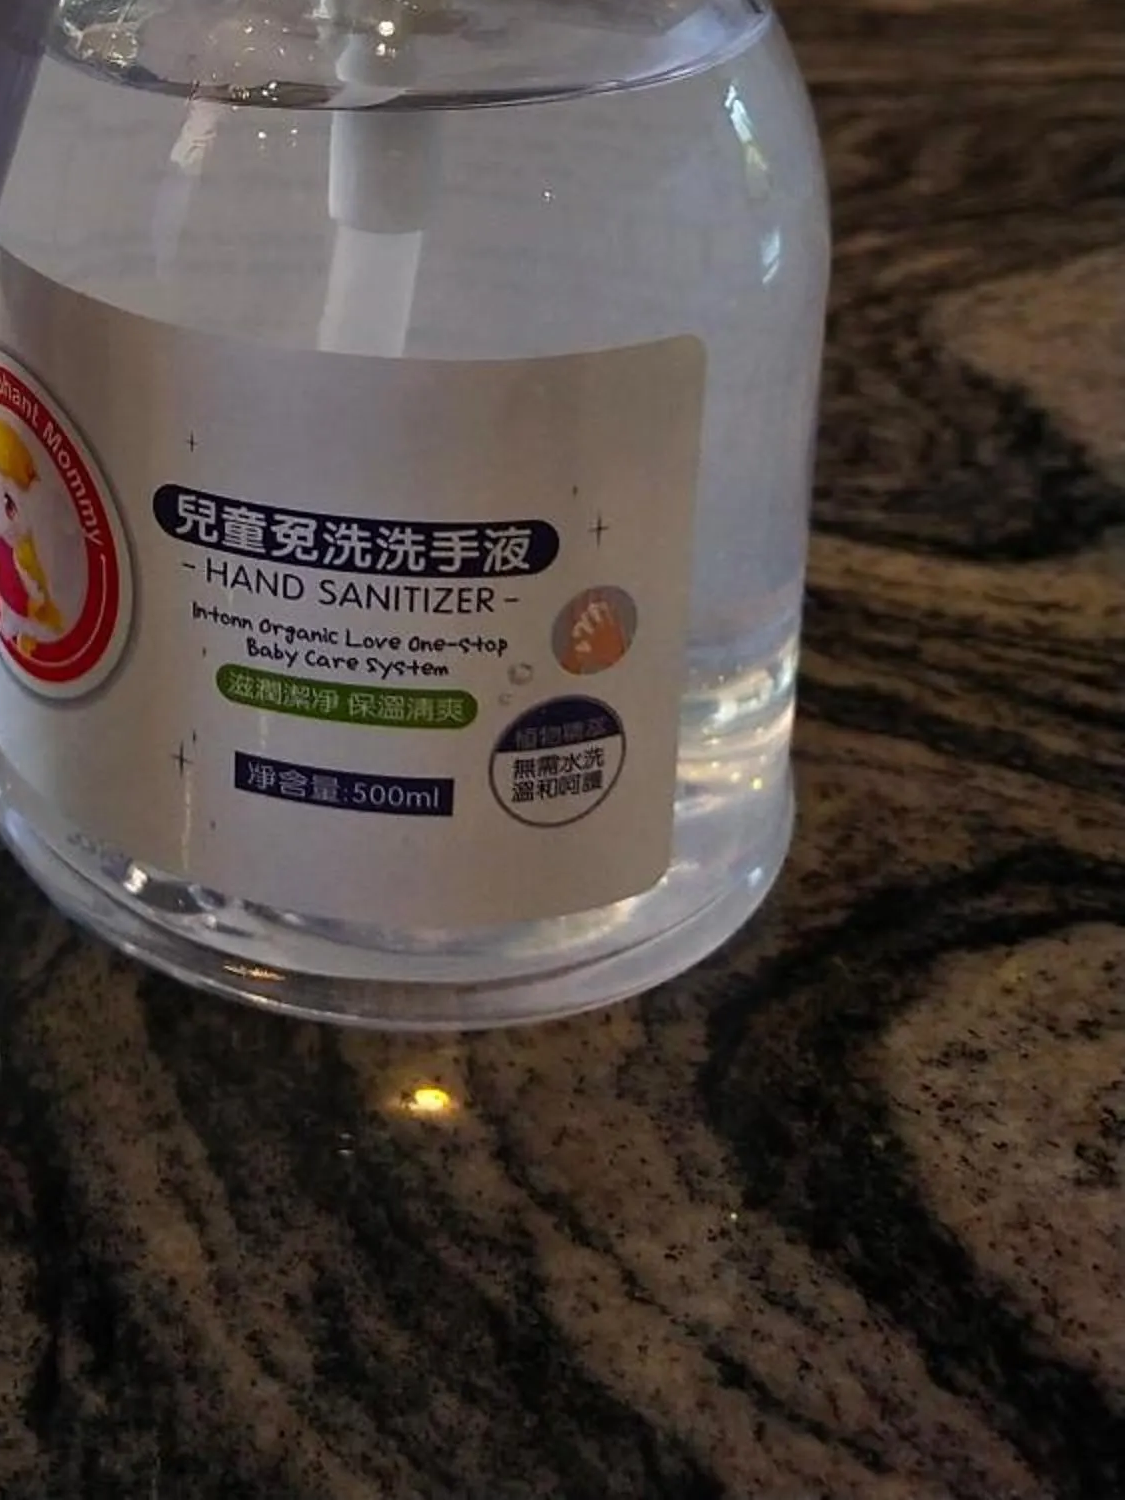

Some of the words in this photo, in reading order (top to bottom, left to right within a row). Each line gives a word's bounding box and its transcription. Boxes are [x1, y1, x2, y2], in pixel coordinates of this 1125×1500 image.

[42, 420, 105, 545] Mommy
[176, 494, 532, 572] 兒童免洗洗手液
[246, 638, 297, 667] Baby
[304, 651, 359, 673] Care
[259, 618, 339, 645] Organic
[345, 630, 401, 650] Love
